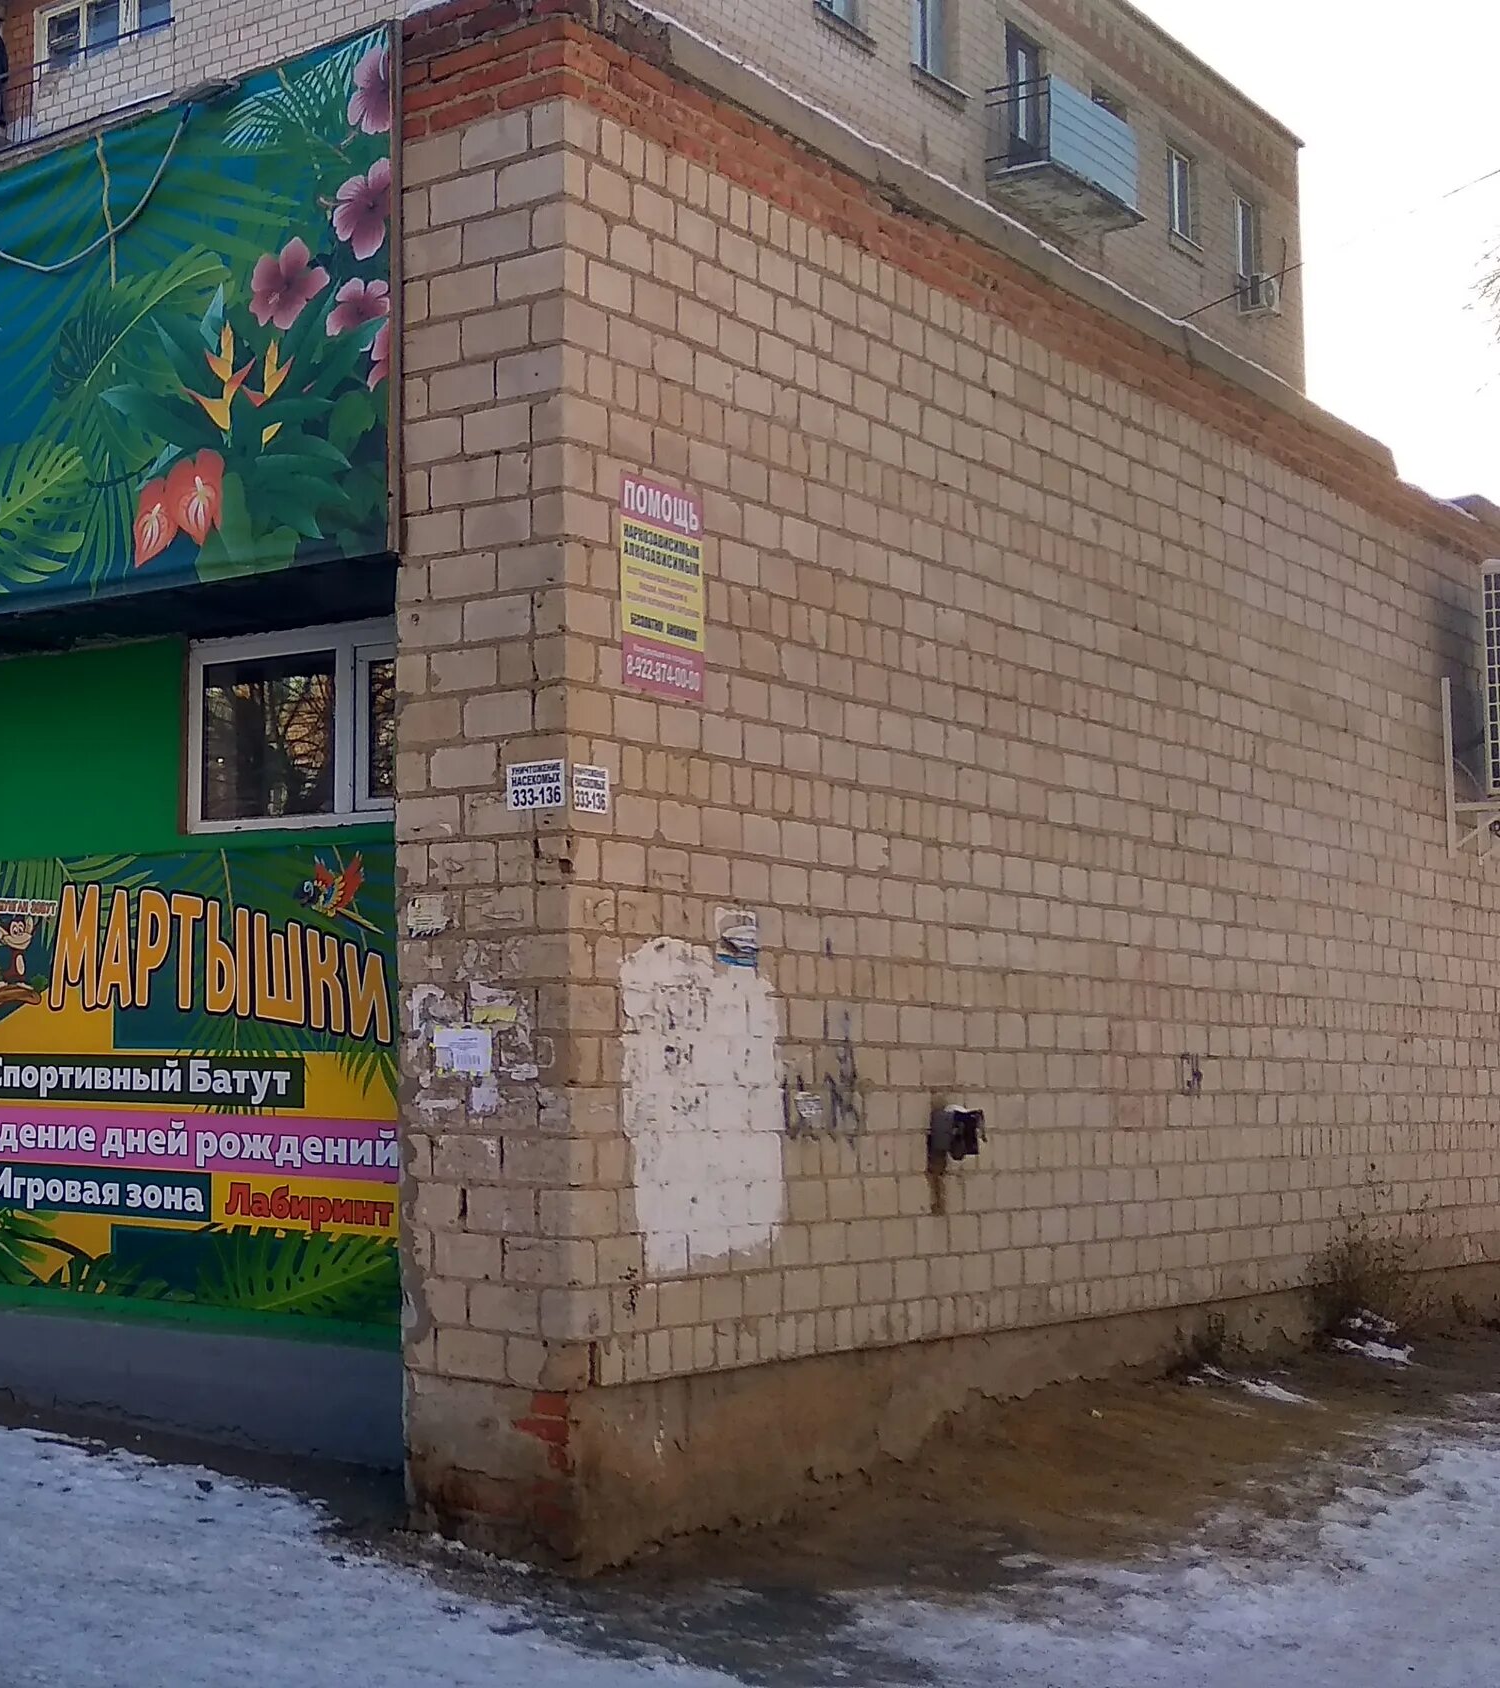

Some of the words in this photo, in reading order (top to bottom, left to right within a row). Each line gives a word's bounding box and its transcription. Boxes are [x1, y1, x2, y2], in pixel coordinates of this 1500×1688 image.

[624, 480, 699, 533] ПОМОЩЬ
[511, 762, 560, 776] УНИЧТОЖЕНИЕ
[511, 773, 560, 787] НАСЕКОМЫХ
[512, 786, 561, 807] 333-136
[50, 883, 392, 1044] МАРТЫШКИ
[188, 1059, 291, 1105] Батут
[100, 1119, 188, 1159] дней
[194, 1127, 399, 1169] рождений
[124, 1182, 204, 1213] зона
[224, 1181, 395, 1231] Лабиринт
